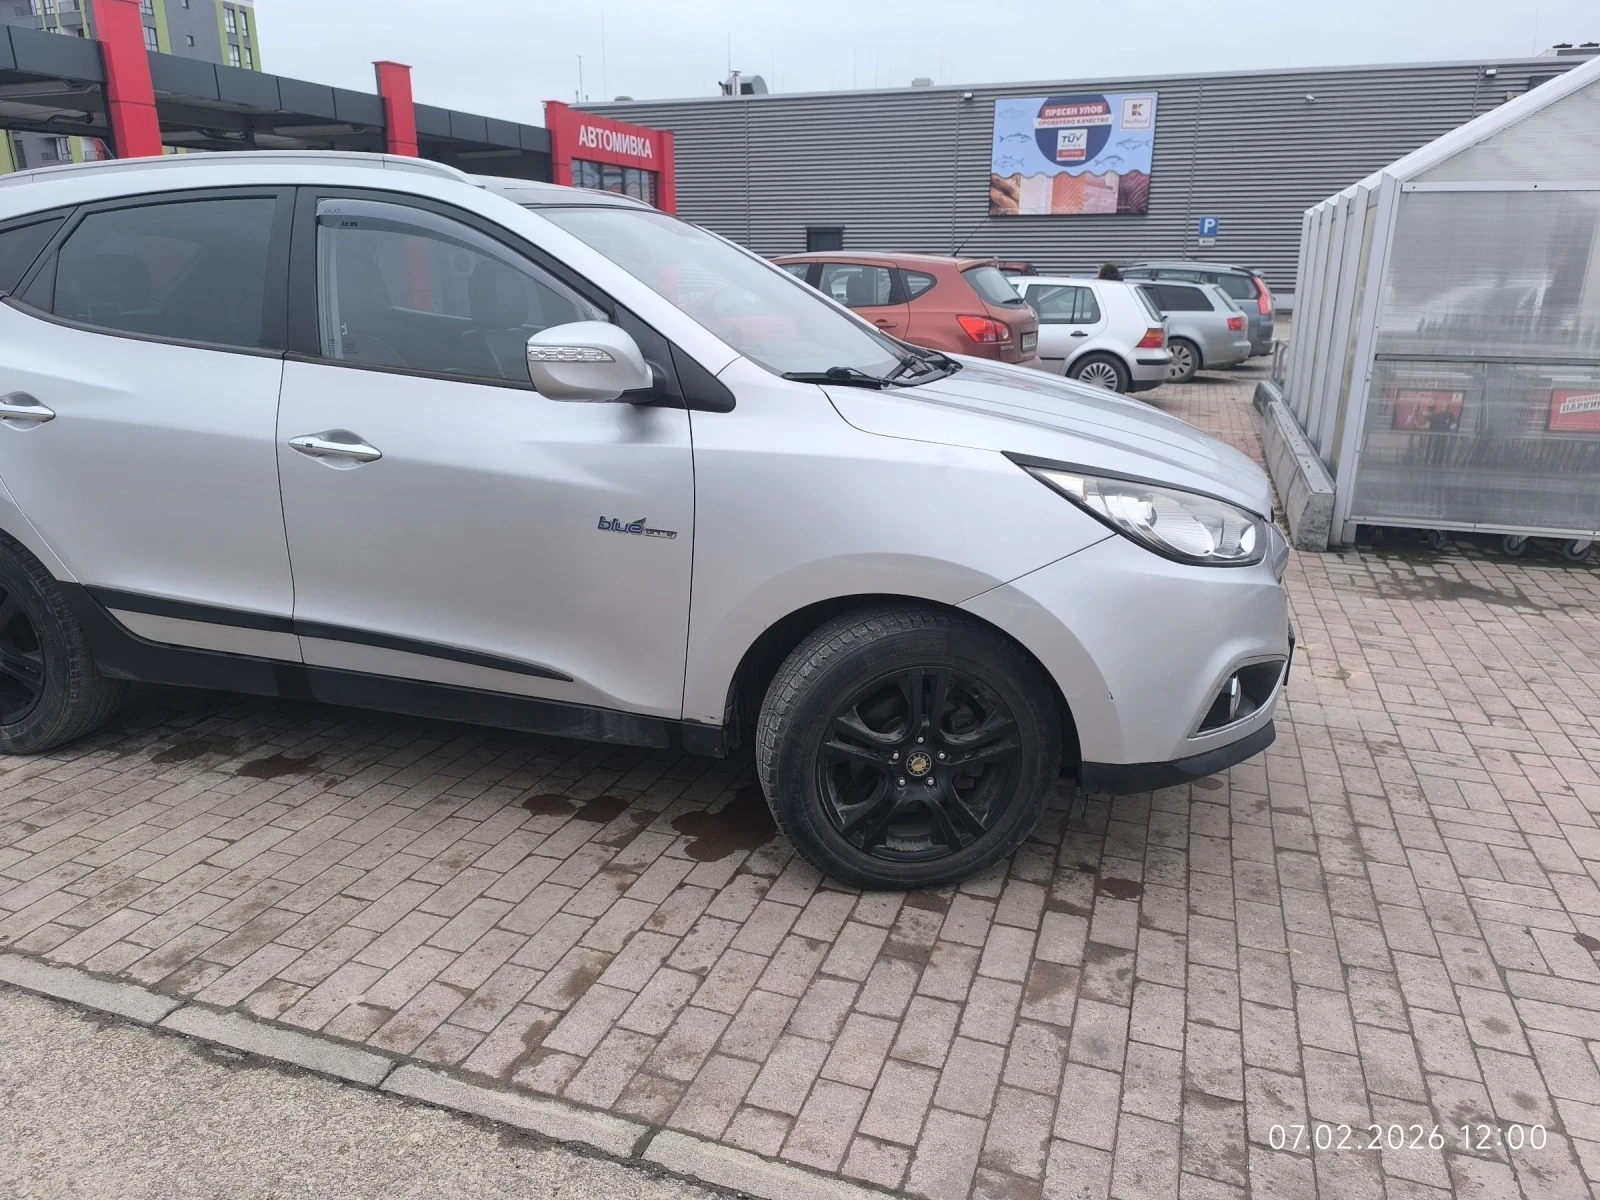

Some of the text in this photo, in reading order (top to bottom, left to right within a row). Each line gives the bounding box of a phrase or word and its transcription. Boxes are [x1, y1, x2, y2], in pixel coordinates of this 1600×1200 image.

[1044, 105, 1103, 117] ПРЕСЕН УЛОВ
[578, 124, 653, 159] АВТОМИВКА
[1061, 132, 1084, 143] TÜV
[1203, 218, 1216, 234] P
[597, 516, 645, 535] blue
